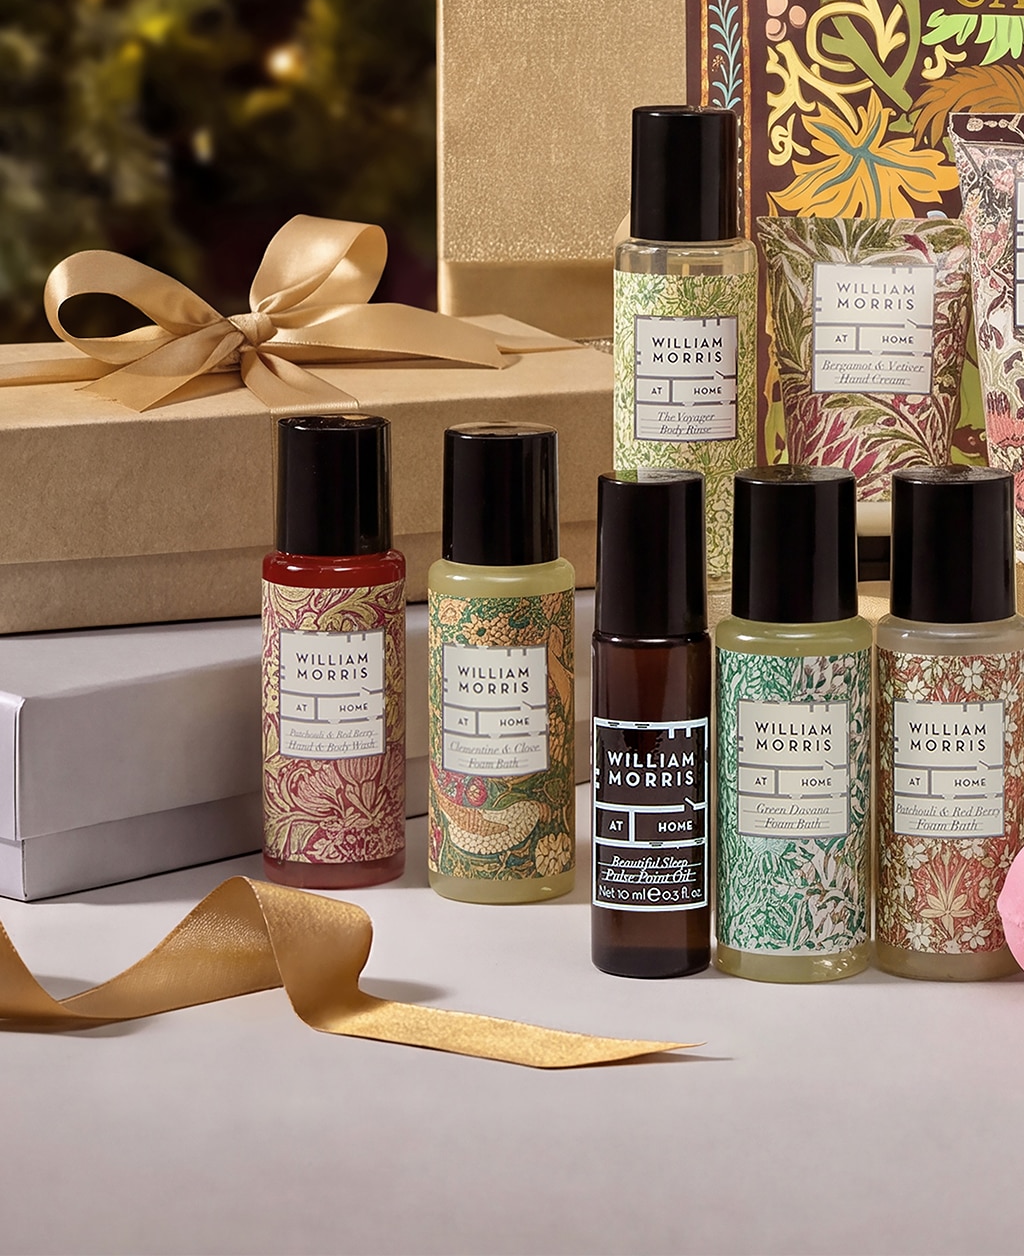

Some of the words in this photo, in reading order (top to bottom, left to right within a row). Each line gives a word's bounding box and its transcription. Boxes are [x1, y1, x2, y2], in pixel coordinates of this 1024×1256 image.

[837, 283, 915, 294] WILLIAM
[838, 298, 914, 310] MORRIS
[652, 337, 722, 348] WILLIAM
[835, 335, 848, 343] AT
[882, 336, 914, 344] HOME
[653, 352, 722, 363] MORRIS
[822, 360, 871, 373] Bergamot
[875, 361, 884, 370] &
[889, 361, 923, 372] Vetiver
[839, 374, 869, 384] Hand
[872, 374, 906, 385] Cream
[658, 412, 675, 422] The
[677, 412, 714, 425] Voyager
[660, 425, 683, 436] Body
[686, 425, 712, 434] Rinse
[296, 653, 368, 665] WILLIAM
[297, 668, 368, 680] MORRIS
[458, 666, 529, 679] WILLIAM
[459, 682, 529, 694] MORRIS
[340, 703, 368, 712] HOME
[500, 718, 530, 726] HOME
[755, 722, 832, 735] WILLIAM
[909, 722, 986, 735] WILLIAM
[288, 740, 312, 751] Hand
[315, 743, 324, 752] &
[326, 742, 350, 753] Body
[352, 739, 376, 750] Wash
[449, 741, 499, 755] Clementine
[502, 745, 511, 754] &
[756, 739, 831, 751] MORRIS
[910, 740, 986, 751] MORRIS
[469, 758, 494, 768] Foam
[496, 758, 519, 769] Bath
[607, 751, 694, 768] WILLIAM
[608, 771, 694, 787] MORRIS
[755, 777, 767, 785] AT
[802, 778, 831, 786] HOME
[955, 778, 986, 787] HOME
[756, 803, 786, 814] Green
[896, 804, 938, 816] Patchouli
[940, 808, 950, 816] &
[952, 807, 972, 817] Red
[975, 806, 1000, 818] Berry
[609, 821, 623, 831] AT
[658, 821, 692, 832] HOME
[764, 818, 794, 828] Foam
[796, 819, 821, 829] Bath
[916, 819, 946, 830] Foam
[951, 820, 977, 831] Bath
[612, 856, 660, 871] Beautiful
[661, 857, 688, 870] Sleep
[606, 869, 636, 881] Pulse
[639, 871, 671, 883] Point
[673, 869, 691, 882] Oil
[599, 885, 615, 898] Net
